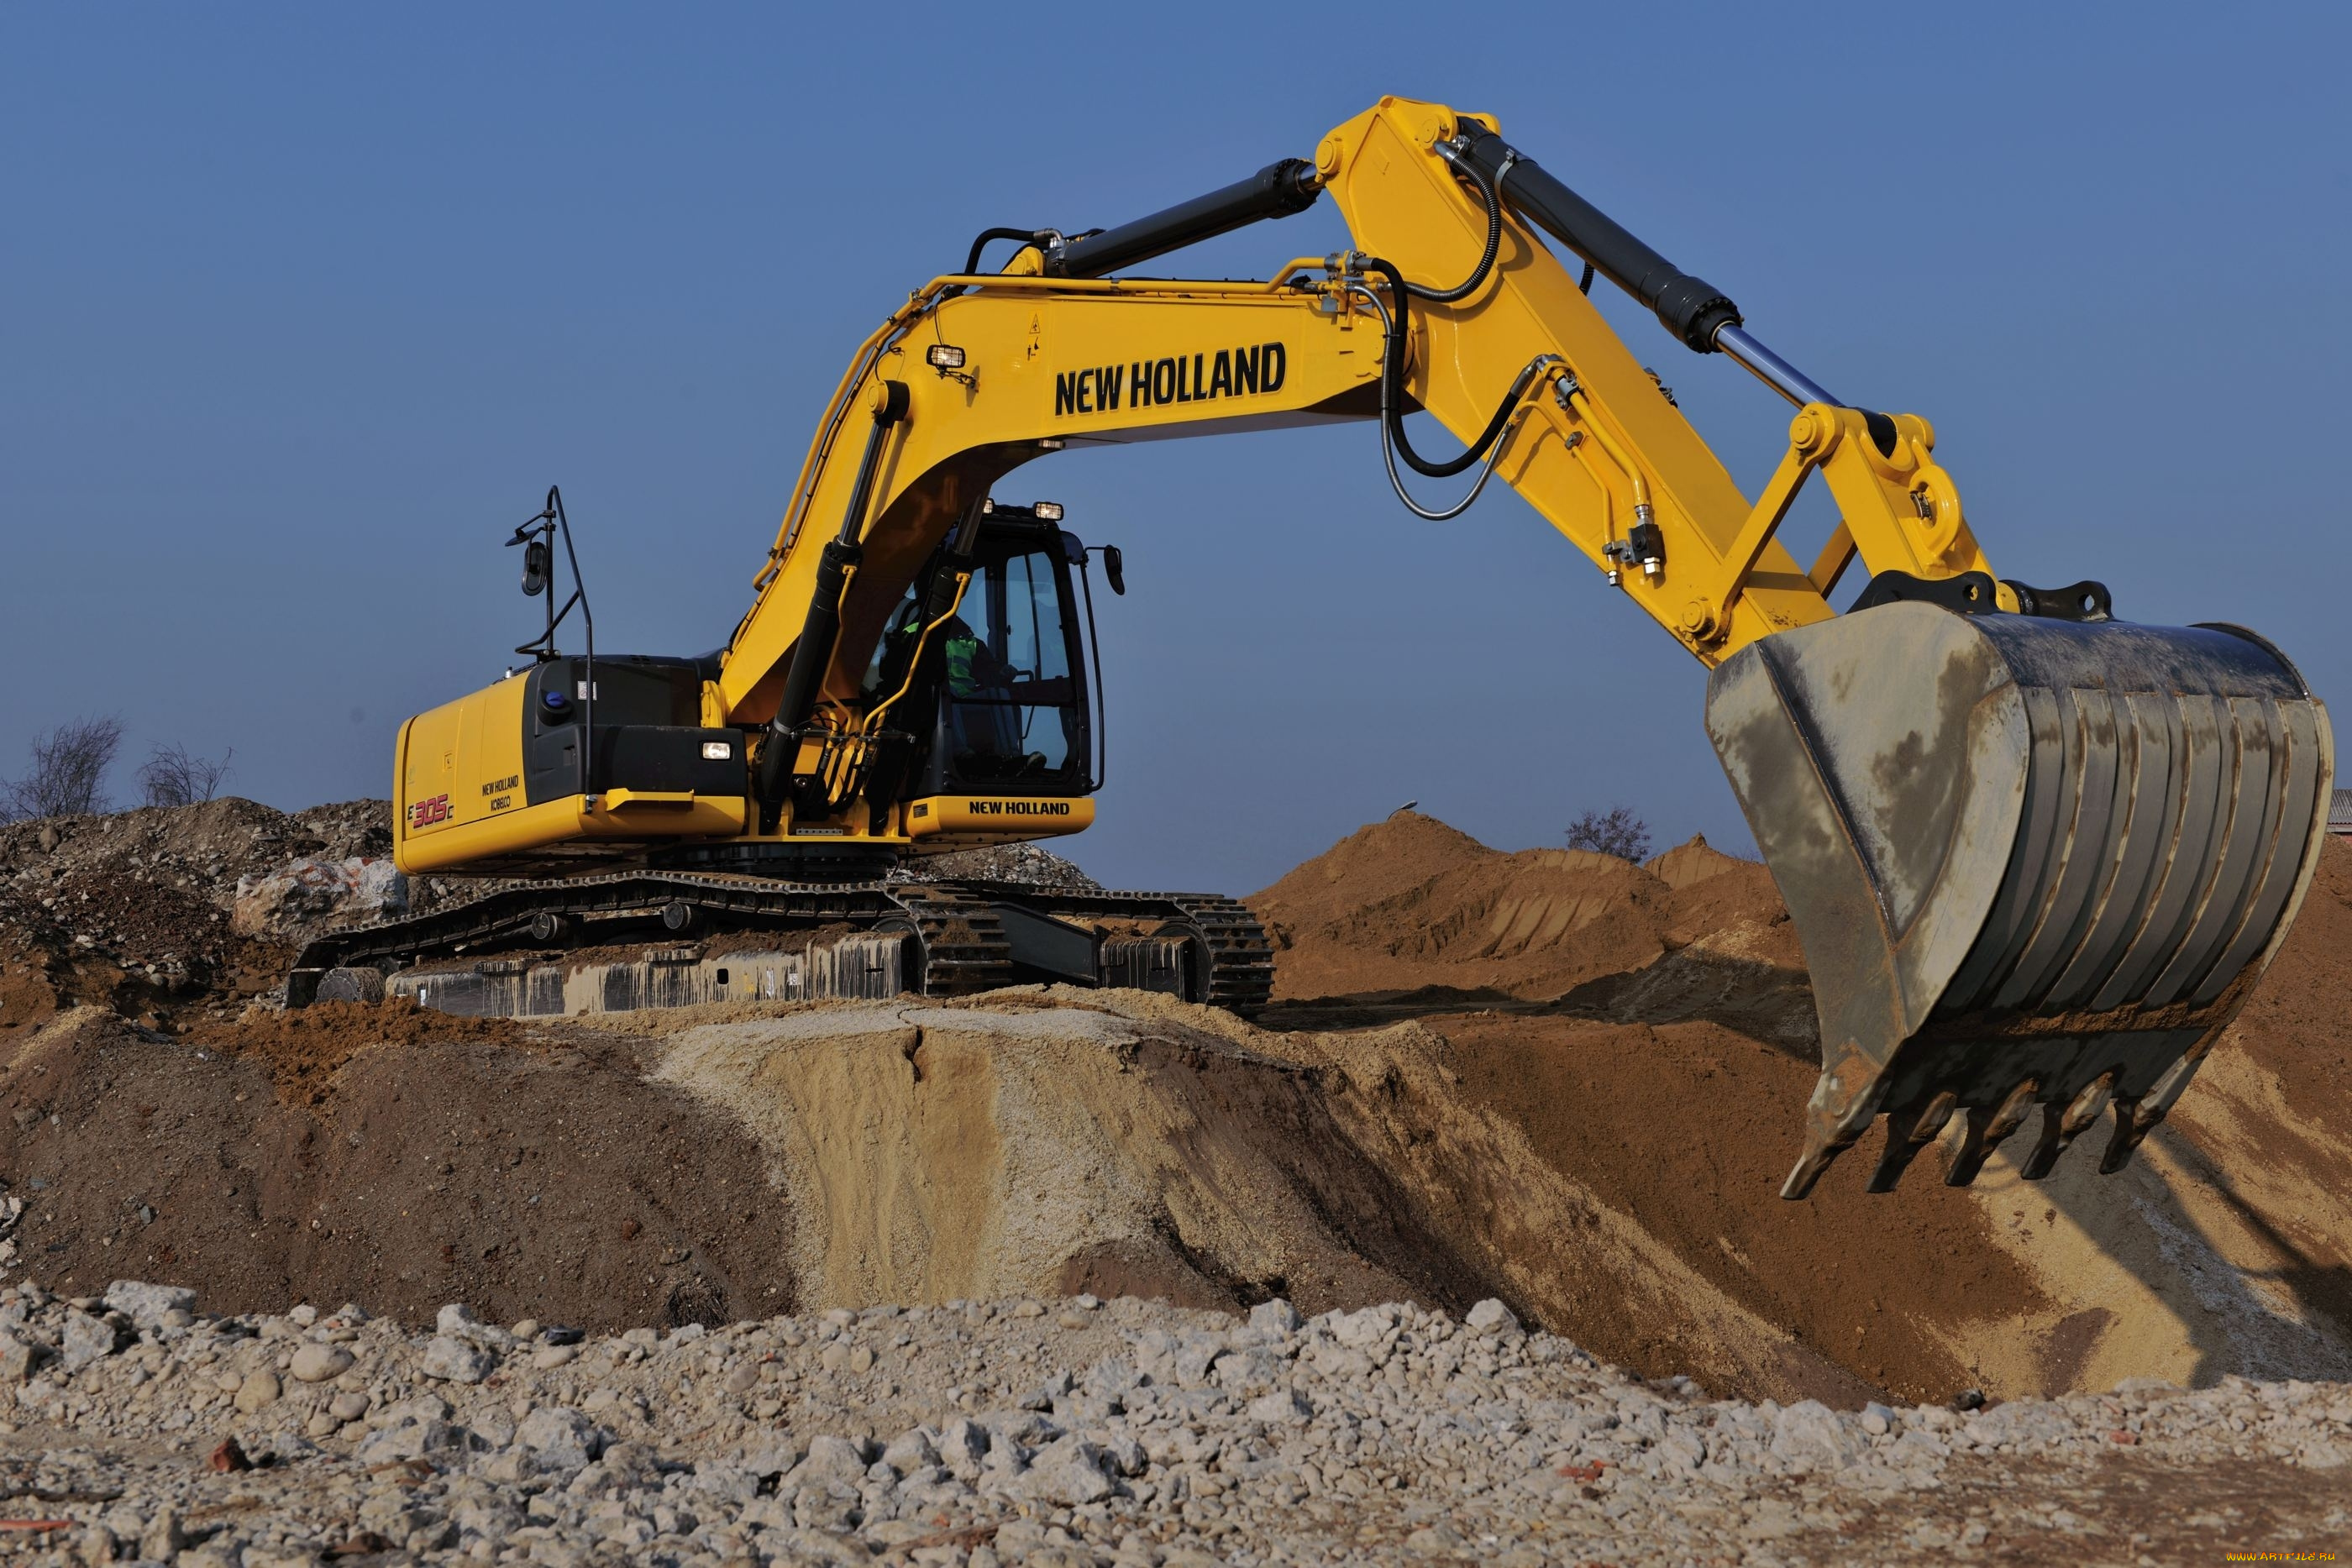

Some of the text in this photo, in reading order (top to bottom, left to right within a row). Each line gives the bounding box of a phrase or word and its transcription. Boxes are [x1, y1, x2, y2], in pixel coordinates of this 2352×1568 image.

[1054, 341, 1286, 417] NEW HOLLAND
[482, 774, 518, 797] NEW HOLLAND
[491, 794, 511, 812] KOBELCO
[969, 801, 1070, 815] NEW HOLLAND
